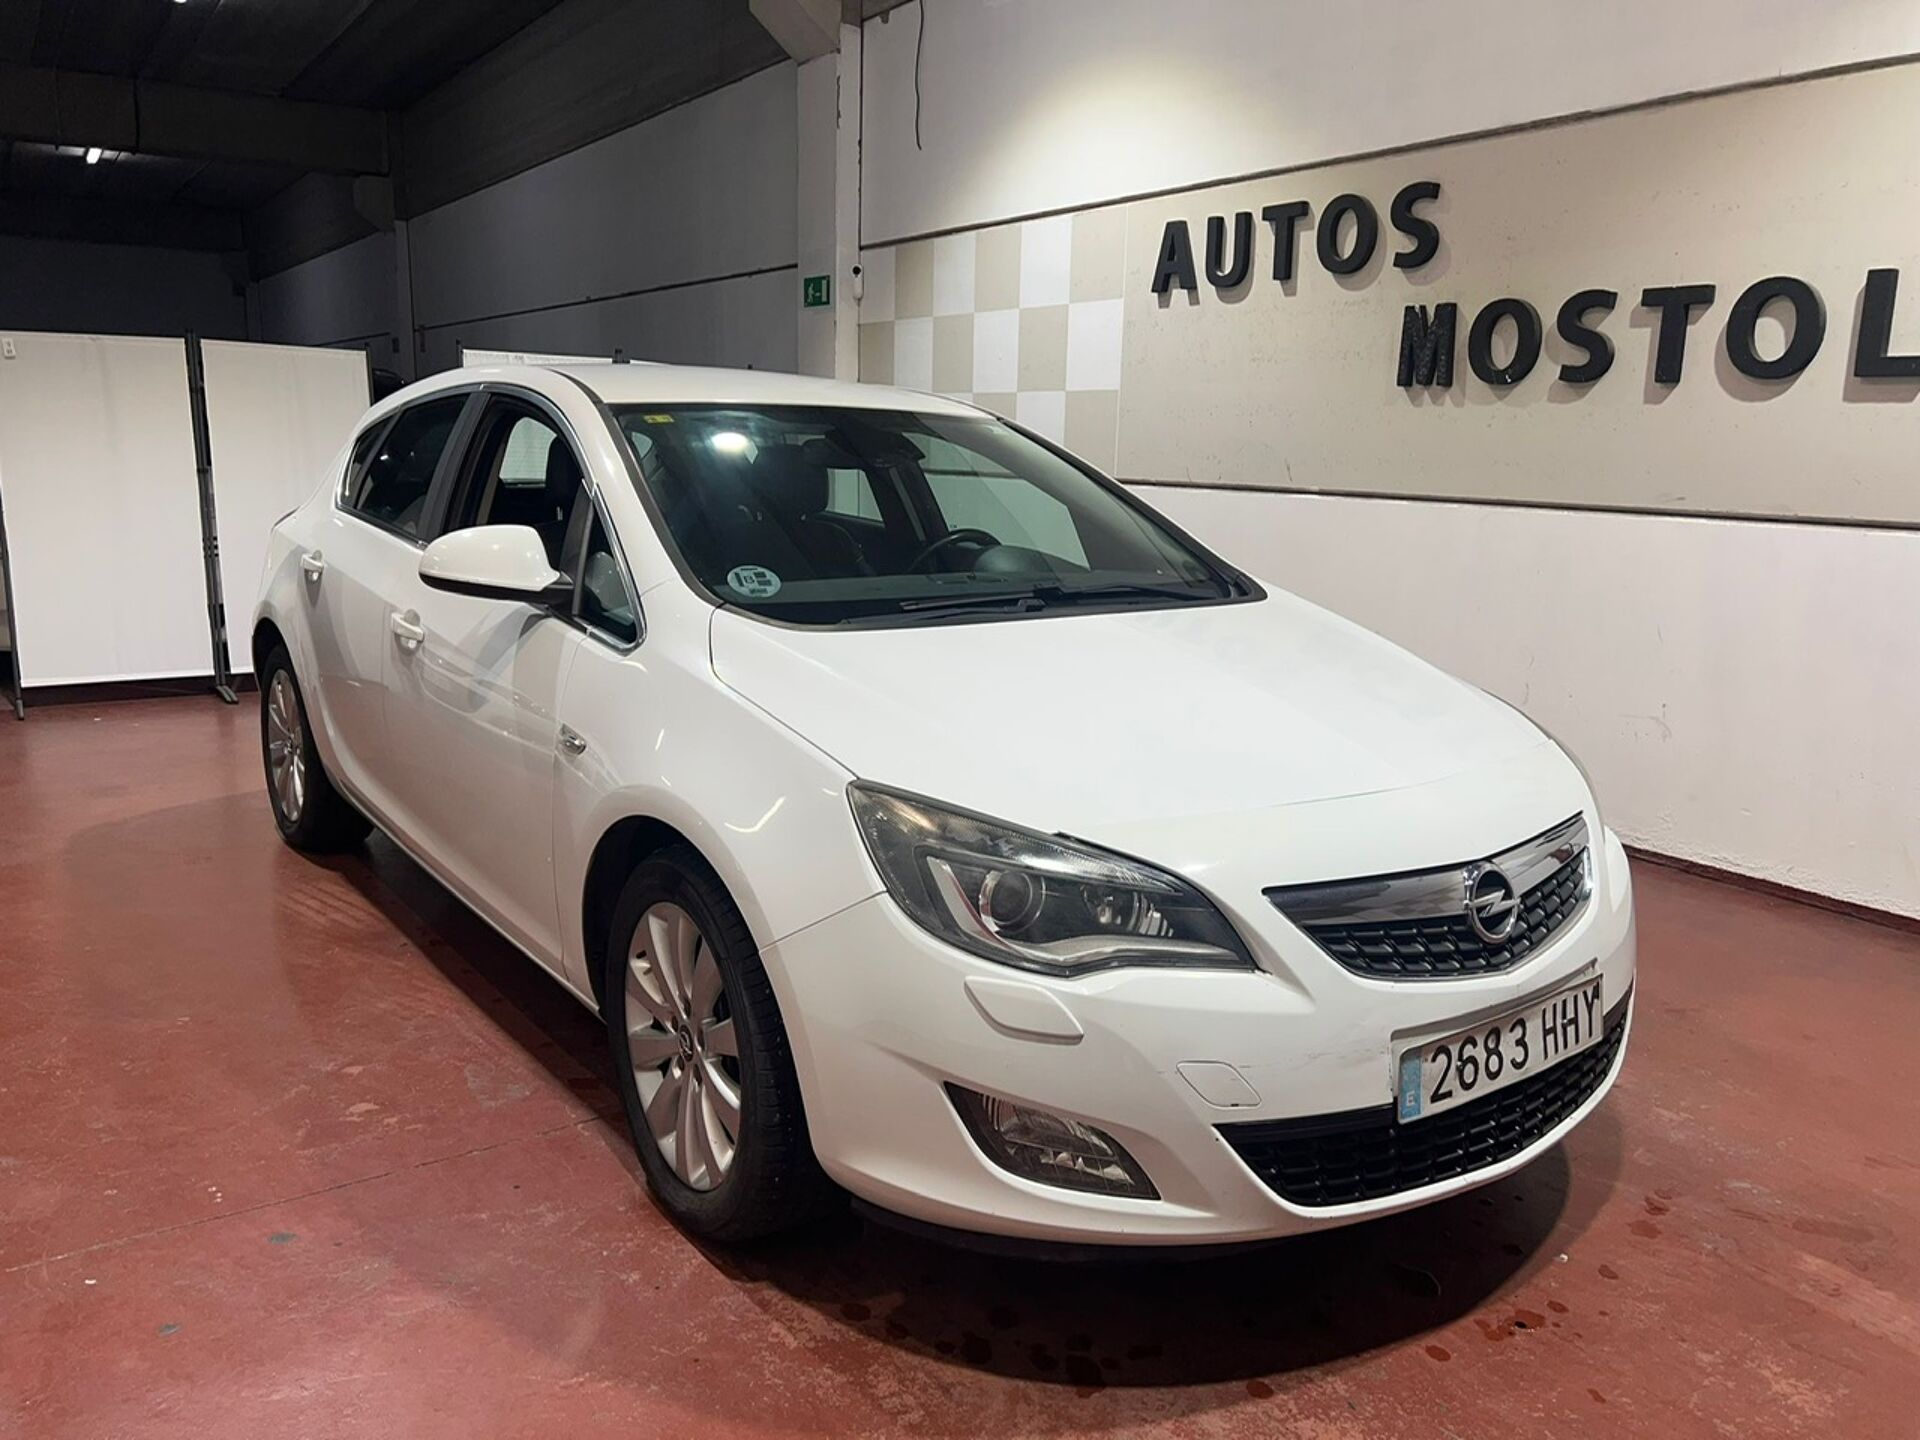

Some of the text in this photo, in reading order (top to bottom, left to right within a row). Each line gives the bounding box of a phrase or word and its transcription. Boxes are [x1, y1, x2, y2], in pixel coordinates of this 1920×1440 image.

[1151, 181, 1442, 293] AUTOS
[1397, 267, 1920, 388] MOSTOL
[1406, 1089, 1416, 1107] E
[1429, 981, 1600, 1104] 2683 HHY
